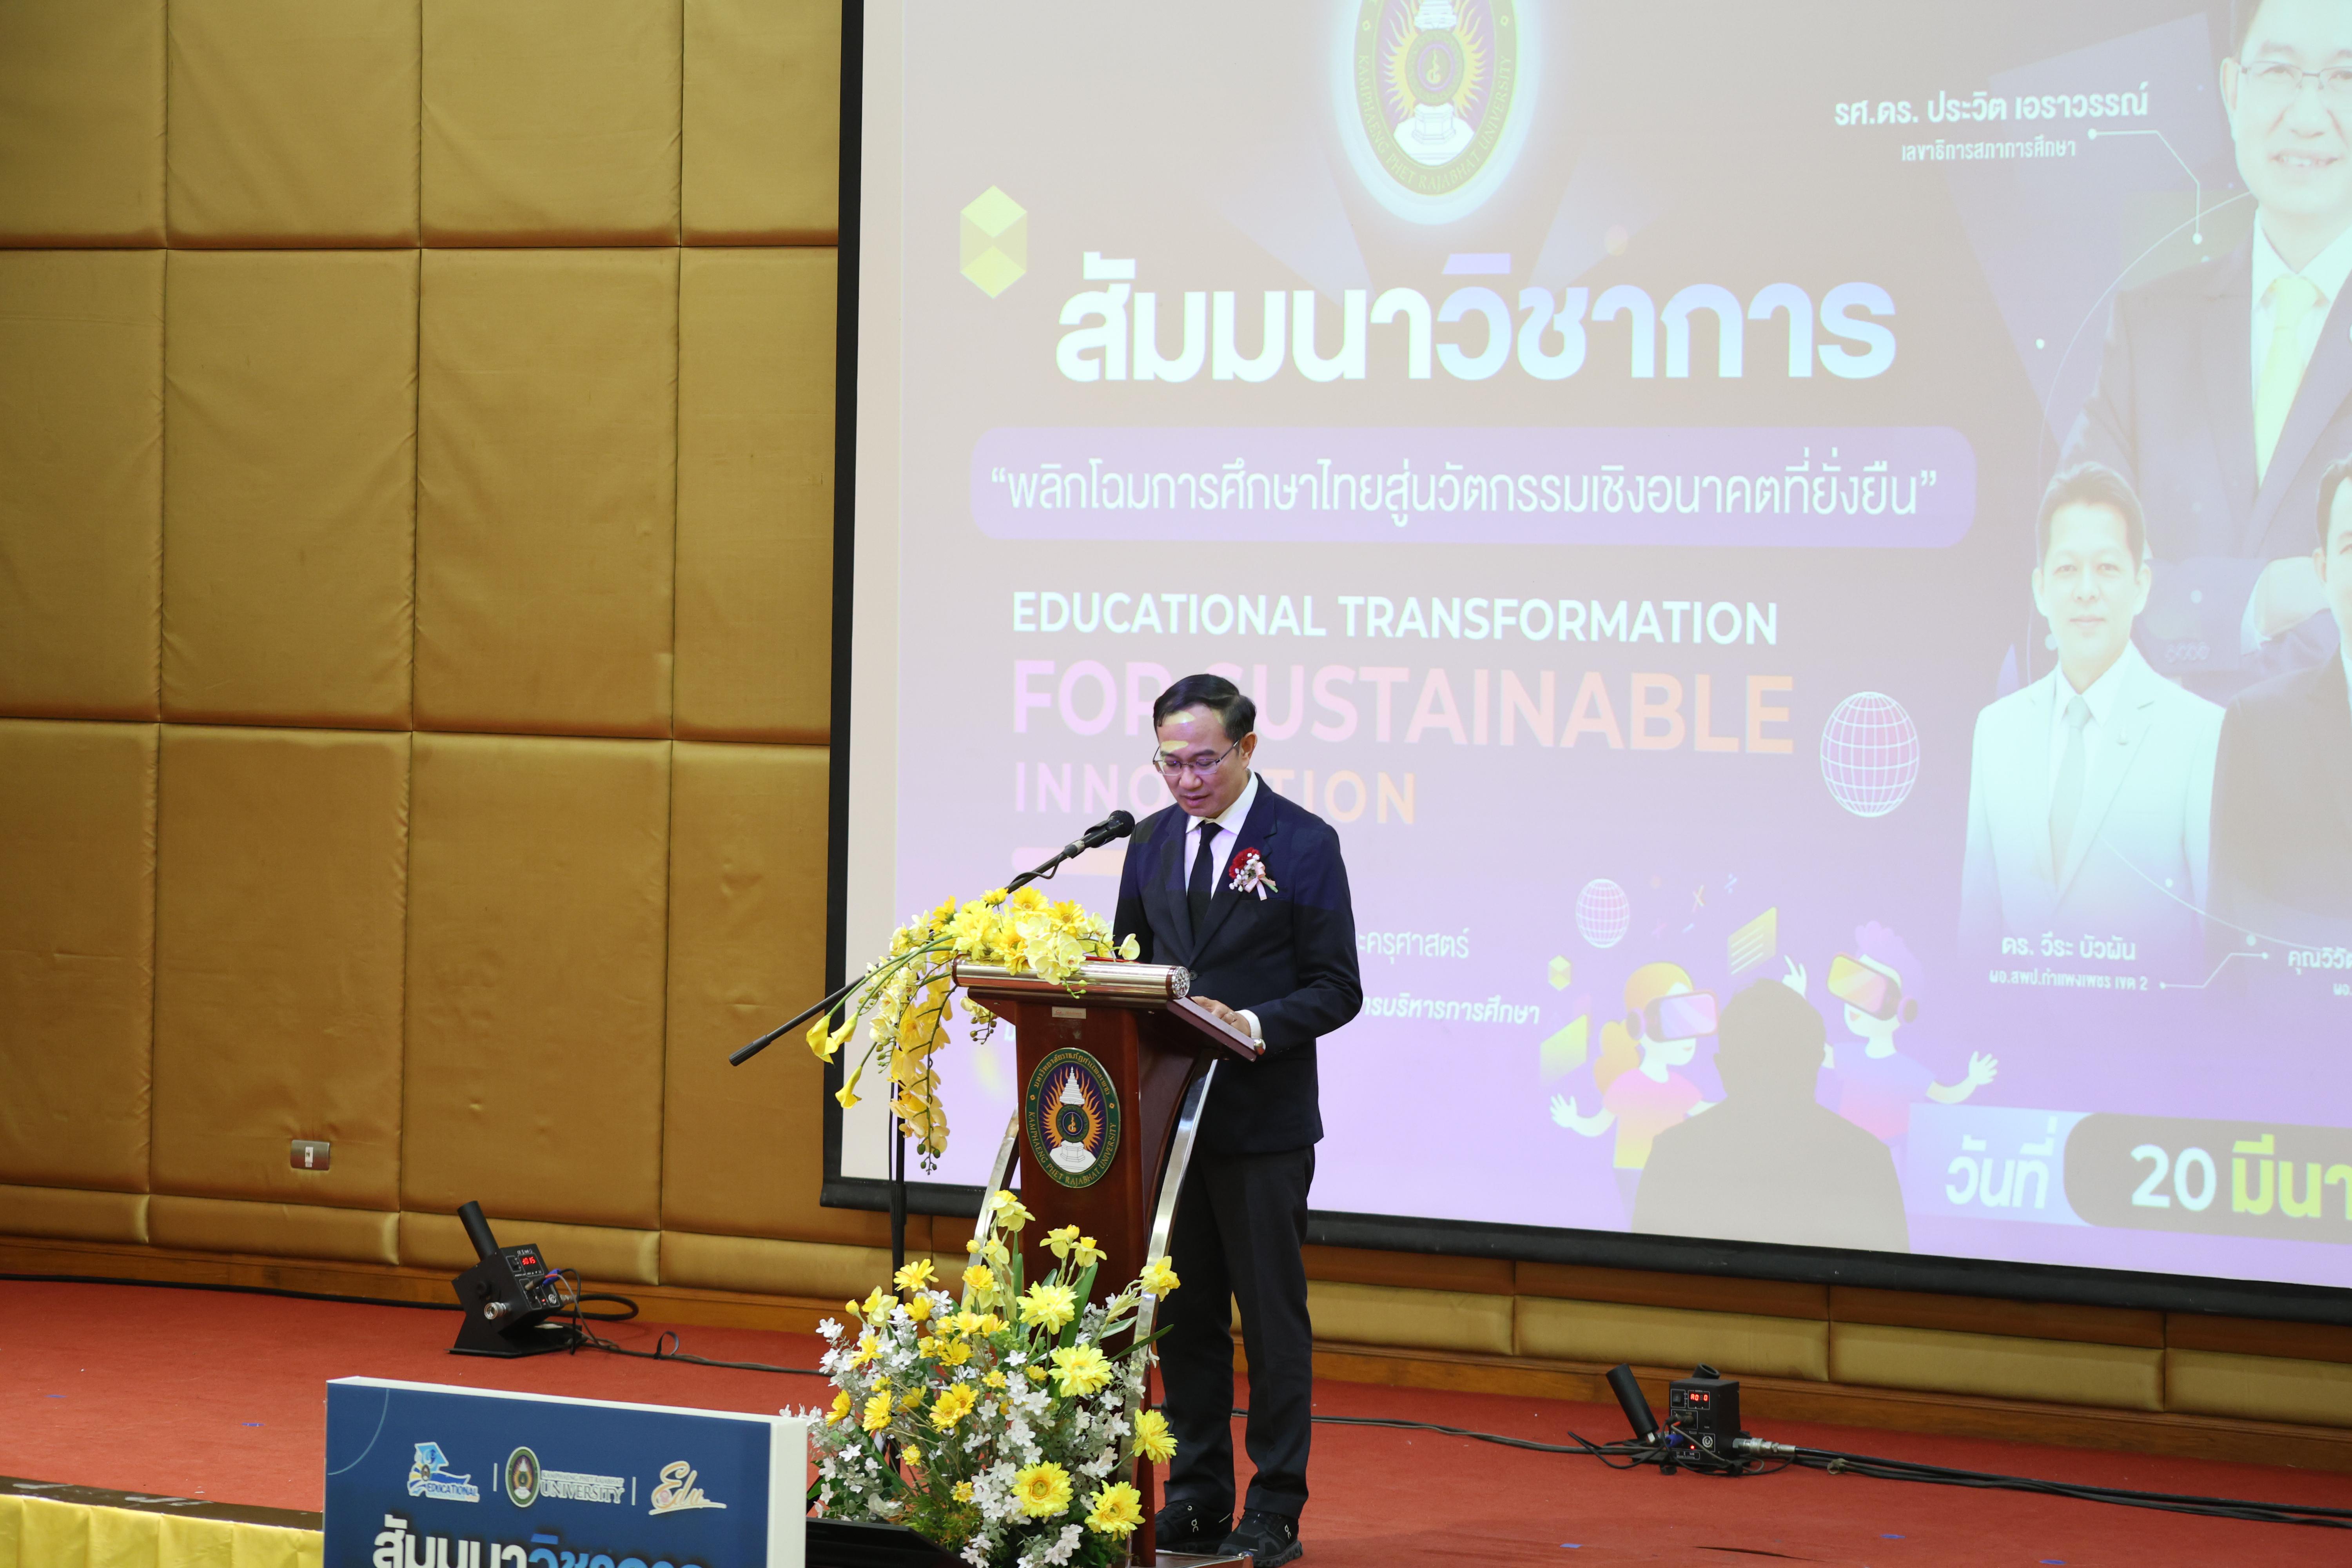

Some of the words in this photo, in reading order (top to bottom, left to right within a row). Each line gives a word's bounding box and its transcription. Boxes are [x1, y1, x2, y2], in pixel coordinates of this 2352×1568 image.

[1358, 55, 1390, 154] KAMPHAENG
[1385, 155, 1415, 184] PHET
[1418, 153, 1483, 192] RAJABHAT
[1481, 56, 1512, 151] UNIVERSITY
[1834, 100, 1919, 125] รศ.ดร.
[1927, 90, 2007, 123] ประวิต
[2015, 81, 2149, 118] เอราวรรณ์
[1056, 251, 1896, 383] สัมมนาวิชาการ
[1013, 591, 1327, 637] EDUCATIONAL
[1338, 596, 1777, 645] TRANSFORMATION
[1013, 659, 1173, 736] FOR
[1204, 662, 1794, 754] USTAINABLE
[1016, 762, 1416, 824] INNOTION
[2001, 936, 2034, 956] ดร.
[2140, 975, 2149, 991] 2
[1029, 1111, 1048, 1163] KAMPHAENG
[1046, 1163, 1063, 1180] PHET
[1065, 1168, 1100, 1186] RAJABHAT
[1098, 1123, 1116, 1169] UNIVERSITY
[1945, 1116, 2059, 1209] วันที่
[2131, 1144, 2217, 1212] 20
[540, 1480, 625, 1504] UNIVERSITY
